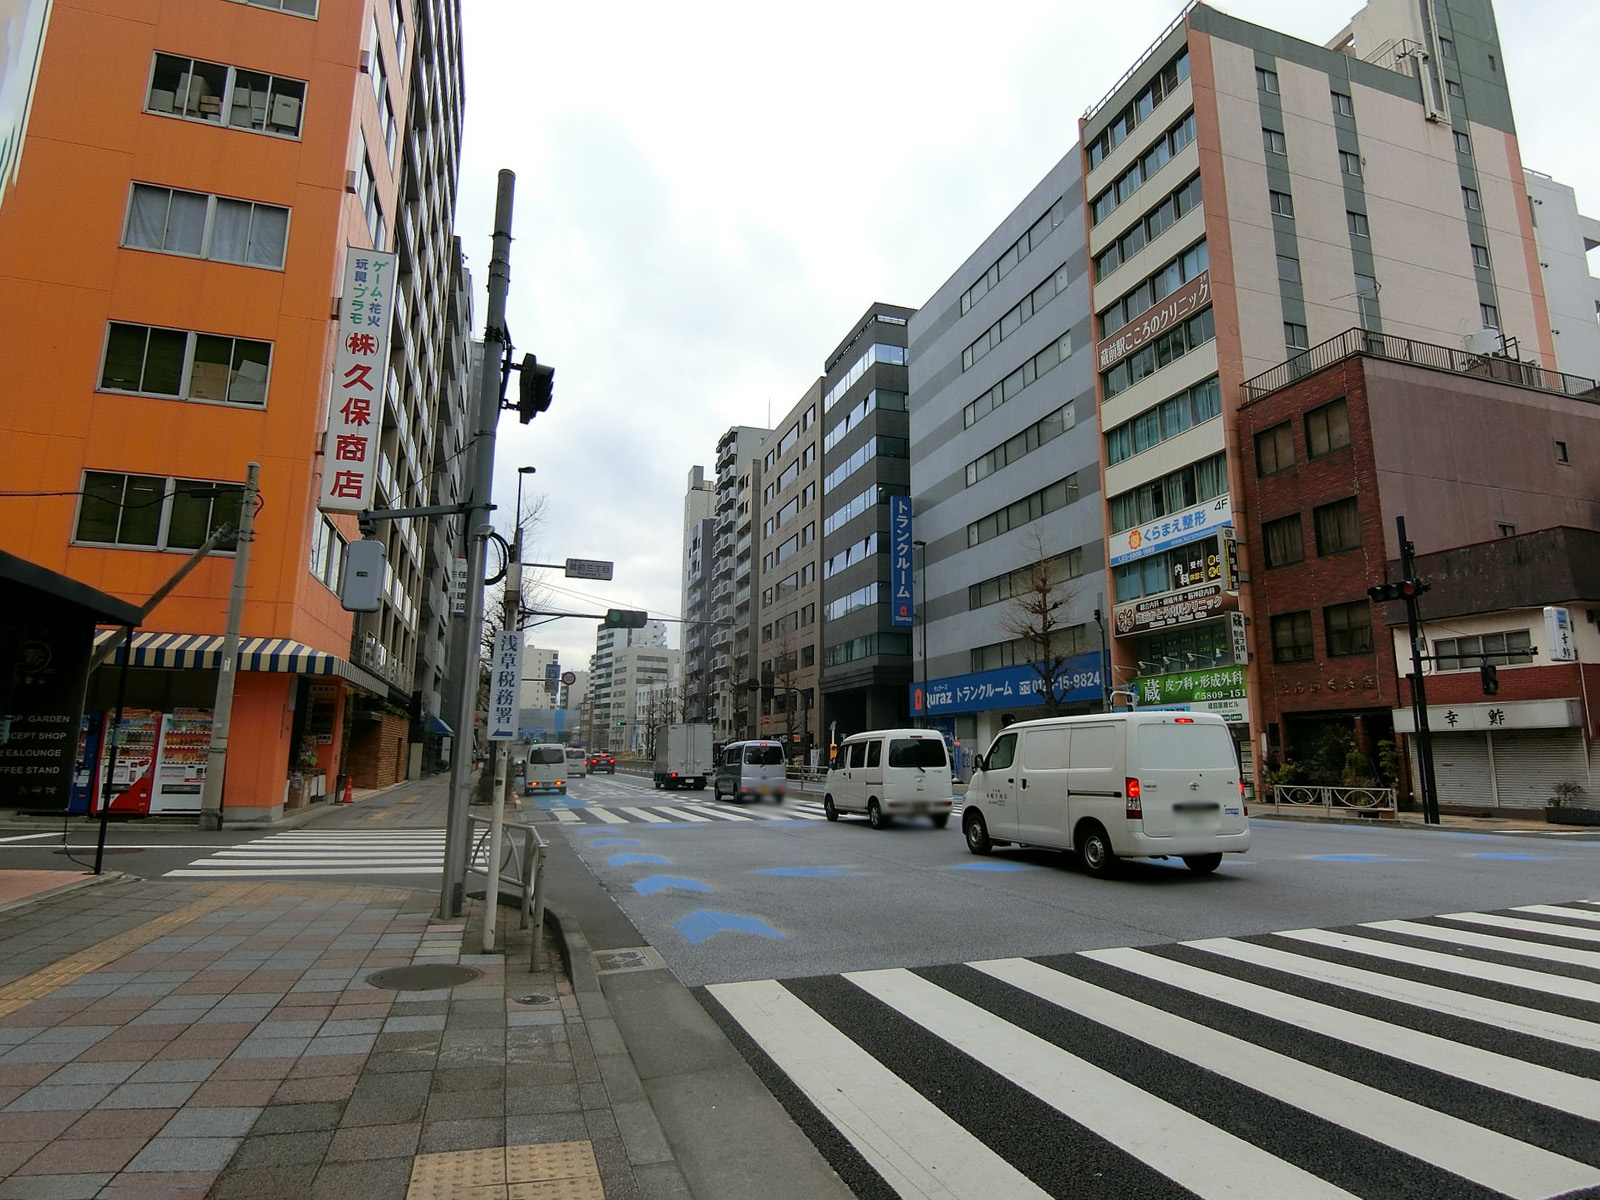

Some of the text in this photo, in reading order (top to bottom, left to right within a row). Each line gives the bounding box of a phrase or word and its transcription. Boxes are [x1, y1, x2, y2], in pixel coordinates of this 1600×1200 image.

[350, 258, 369, 325] 玩具・プラモ
[367, 260, 389, 327] ゲーム・花火
[1100, 283, 1208, 368] 蔵前駅こころのクリニック
[1214, 498, 1228, 511] 4F
[1143, 509, 1207, 542] くらまえ整形
[895, 500, 910, 598] トランクルーム
[494, 634, 518, 724] 浅草税務署
[956, 680, 1012, 704] トランクルーム
[1032, 671, 1101, 694] 012-15-9824
[1144, 679, 1161, 702] 蔵
[1165, 670, 1243, 692] 皮フ科・形成外科
[28, 714, 71, 724] GARDEN
[38, 731, 68, 740] SHOP
[25, 765, 60, 774] STAND
